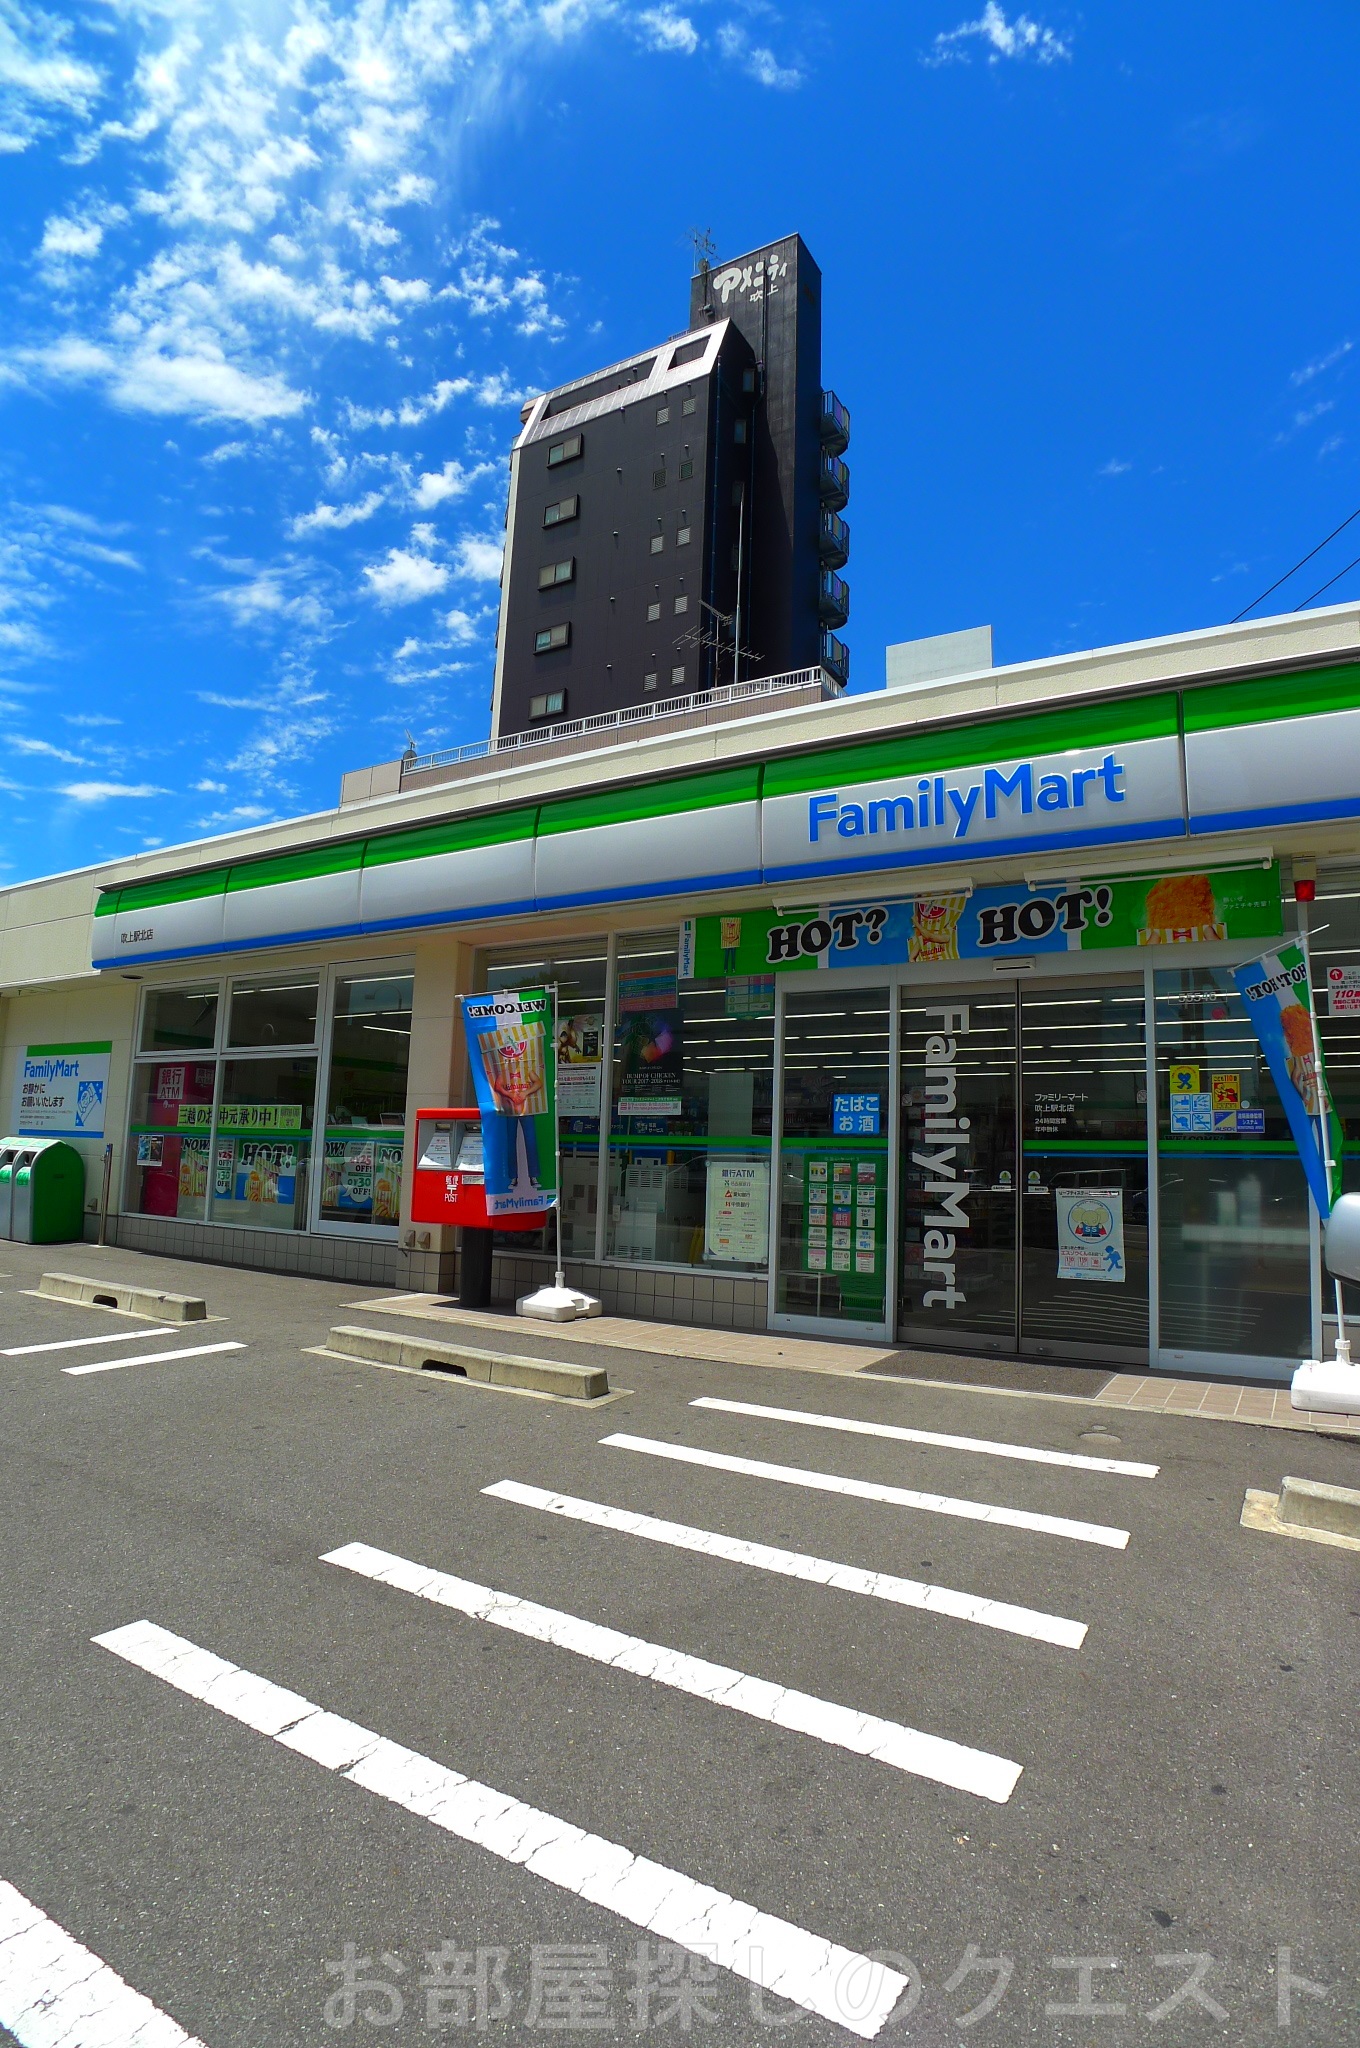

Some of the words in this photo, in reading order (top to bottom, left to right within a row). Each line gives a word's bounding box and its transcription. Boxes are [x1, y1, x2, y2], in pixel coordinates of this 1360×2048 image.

[808, 751, 1126, 843] FamilyMart
[978, 886, 1113, 946] HOT!
[767, 906, 888, 963] HOT?
[683, 933, 691, 977] FamilyMart
[24, 1060, 80, 1082] FamilyMart
[161, 1068, 182, 1085] 銀行
[159, 1086, 181, 1099] ATM
[1034, 1092, 1089, 1103] ファミリーマート
[834, 1096, 880, 1113] たばこ
[1034, 1103, 1075, 1113] 吹上駅北店
[838, 1114, 875, 1132] お酒
[1034, 1117, 1067, 1125] 24時間営業
[241, 1143, 294, 1169] HOT!
[324, 1141, 346, 1156] OW!
[380, 1147, 403, 1164] NO
[911, 1004, 971, 1310] FamilyMart
[355, 1164, 372, 1173] OFF!
[722, 1169, 755, 1178] 銀行ATM
[445, 1175, 459, 1185] 郵便
[352, 1187, 371, 1196] OFF!
[444, 1193, 459, 1202] POST
